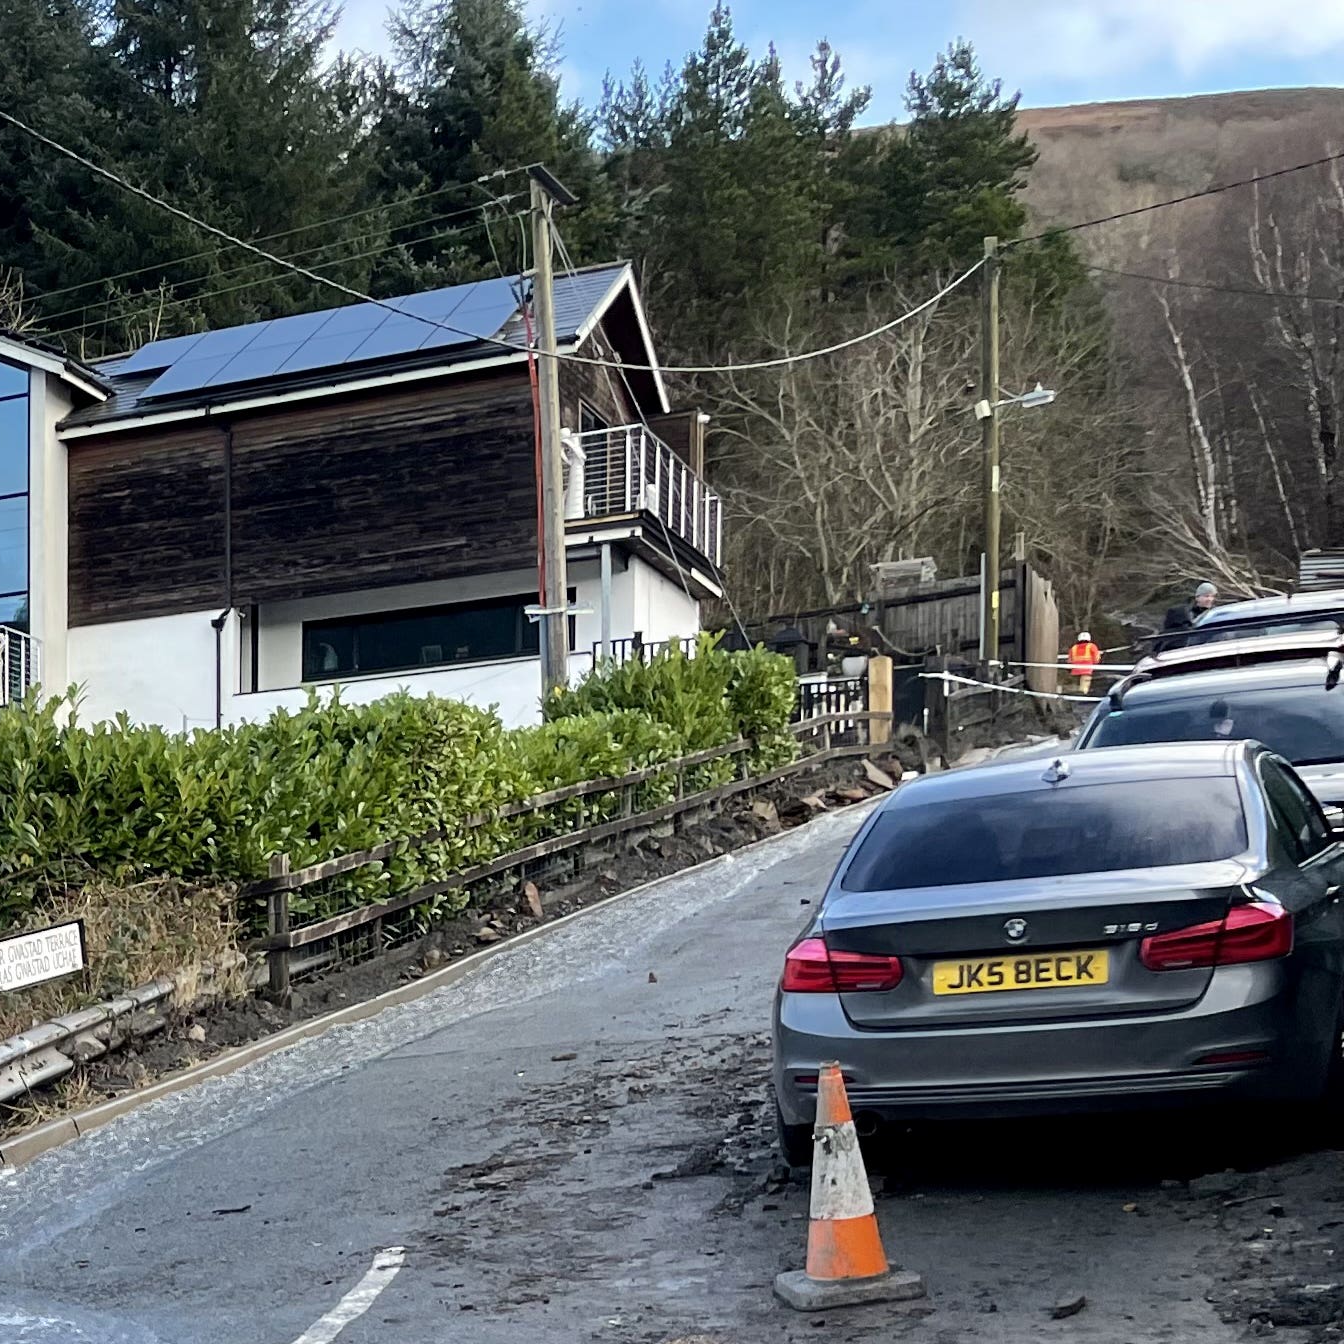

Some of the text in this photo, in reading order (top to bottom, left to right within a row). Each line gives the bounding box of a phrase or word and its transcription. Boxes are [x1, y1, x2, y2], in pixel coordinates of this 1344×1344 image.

[8, 938, 43, 962] GWASTAD
[45, 929, 78, 953] TERRACE
[15, 955, 50, 980] GWASTAD
[947, 961, 1004, 989] JK5
